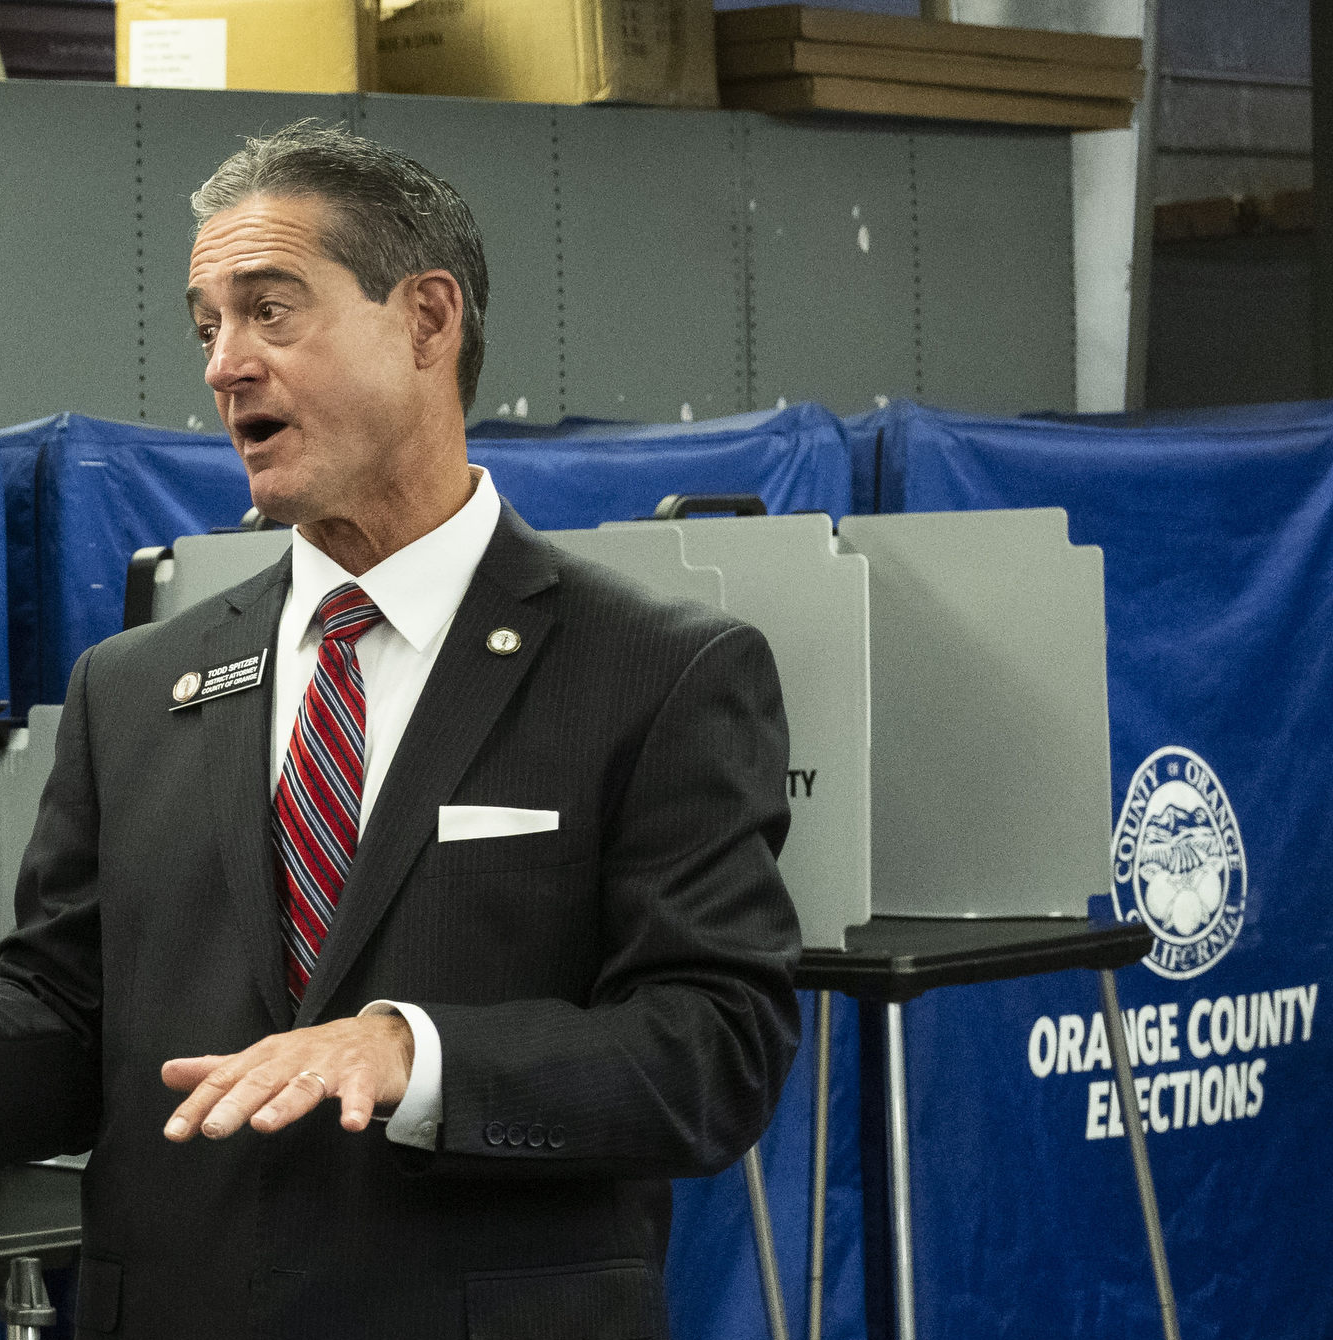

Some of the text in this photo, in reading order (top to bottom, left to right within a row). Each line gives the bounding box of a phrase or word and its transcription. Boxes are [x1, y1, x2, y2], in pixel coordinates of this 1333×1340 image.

[201, 672, 258, 695] COUNTY OF ORANGE
[204, 666, 258, 687] DISTRICT ATTORNEY
[207, 656, 259, 679] TODD SPITZER
[1114, 762, 1160, 884] COUNTY
[1184, 760, 1243, 871] ORANGE
[1028, 983, 1319, 1079] ORANGE COUNTY
[1085, 1058, 1268, 1141] ELECTIONS
